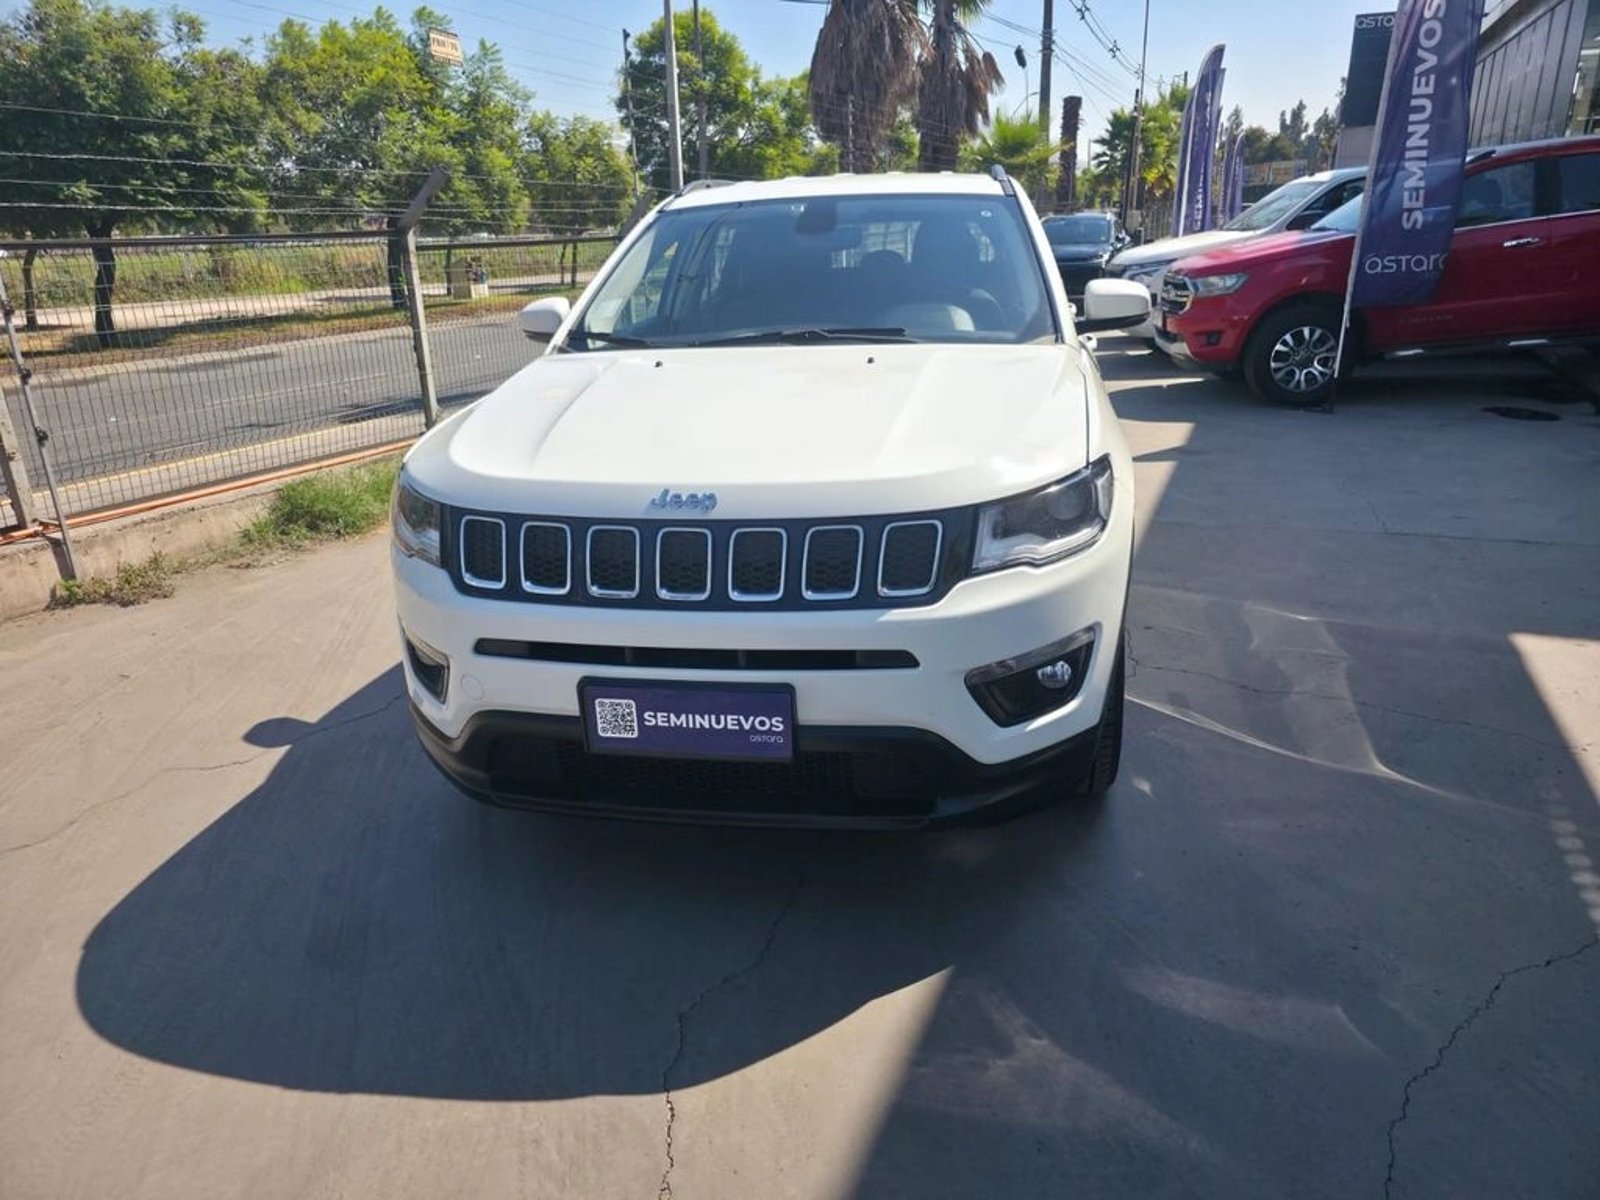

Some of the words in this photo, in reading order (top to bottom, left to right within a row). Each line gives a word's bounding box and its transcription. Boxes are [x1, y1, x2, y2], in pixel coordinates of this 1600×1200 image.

[1355, 15, 1396, 29] asta
[1402, 0, 1447, 230] SEMINUEVOS
[650, 488, 718, 513] Jeep
[643, 711, 785, 732] SEMINUEVOS
[750, 735, 784, 743] astara
